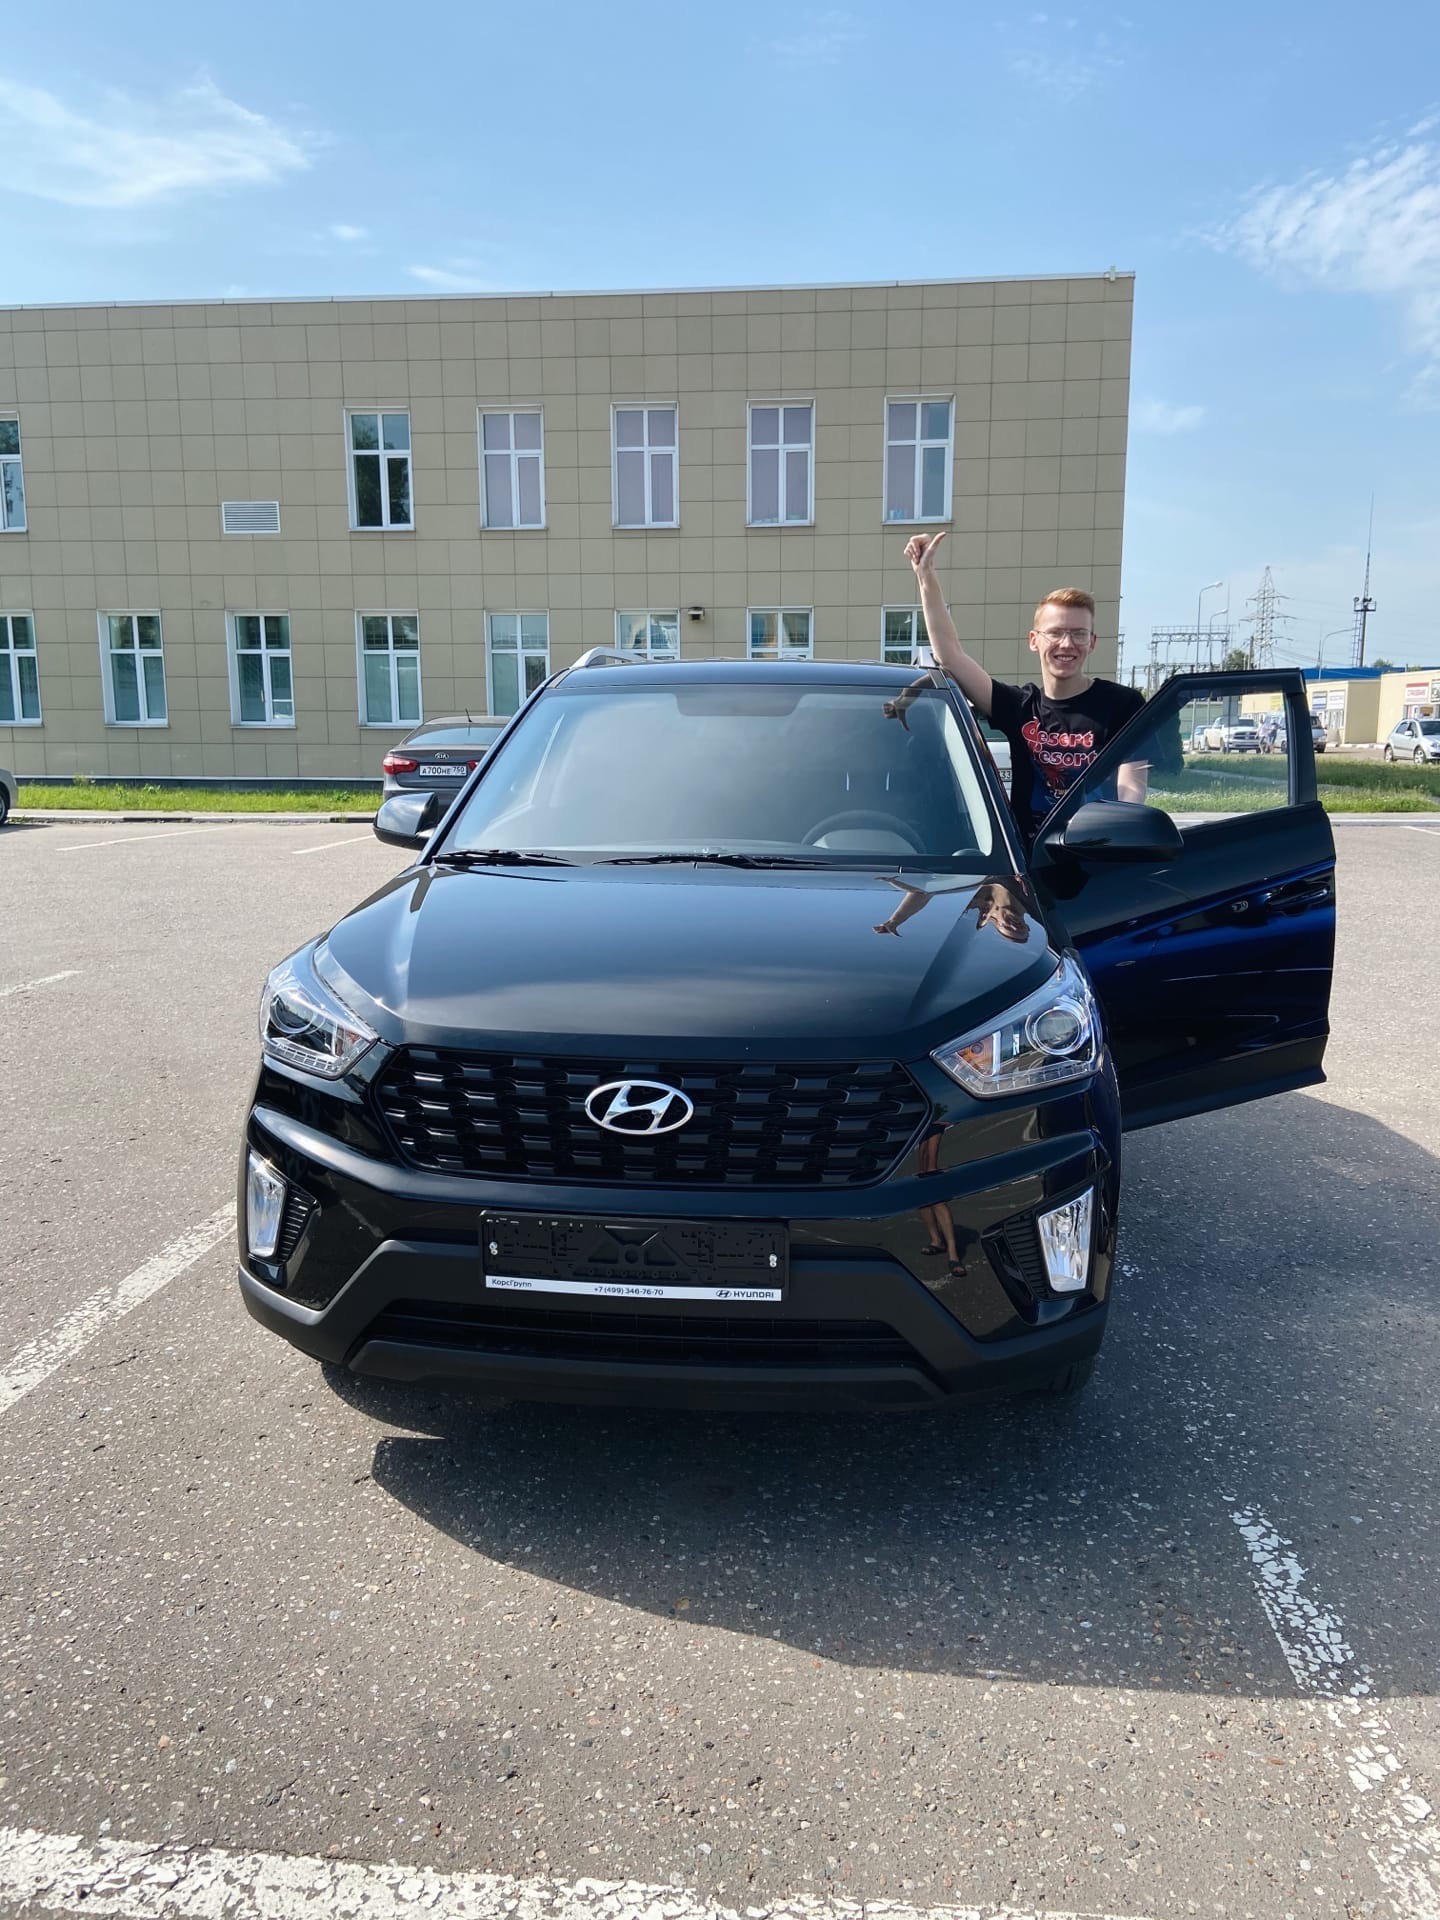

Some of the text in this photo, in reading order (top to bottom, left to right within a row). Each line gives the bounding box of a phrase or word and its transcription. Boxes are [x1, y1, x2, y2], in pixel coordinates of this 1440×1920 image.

[491, 1279, 532, 1288] КорсГрупп
[604, 1287, 624, 1295] (499)
[625, 1288, 664, 1296] 346-76-70
[733, 1291, 775, 1299] HYUNDAI
